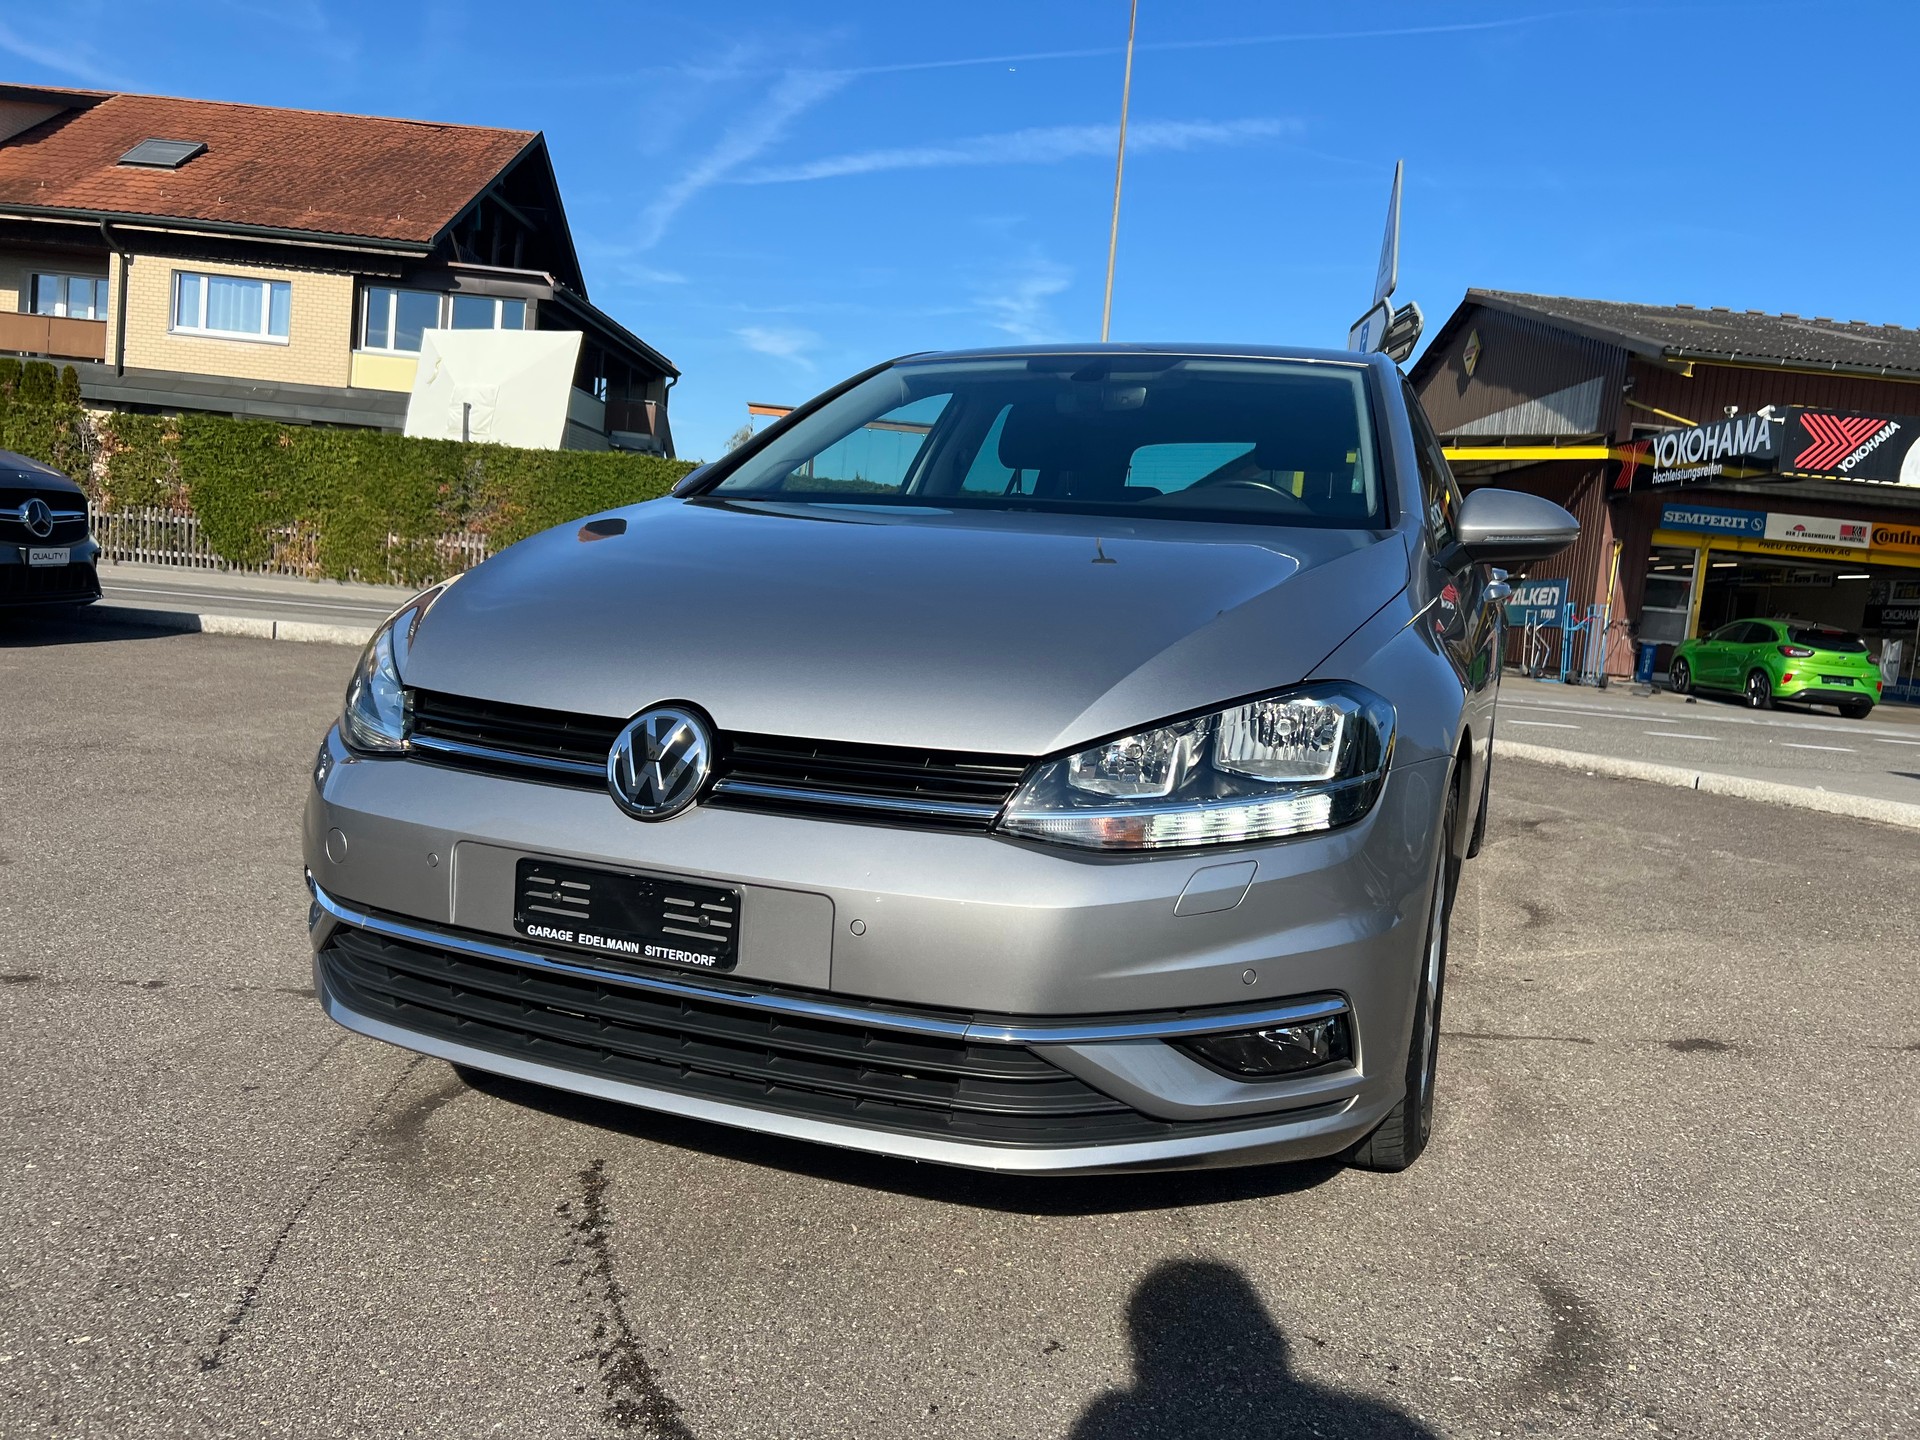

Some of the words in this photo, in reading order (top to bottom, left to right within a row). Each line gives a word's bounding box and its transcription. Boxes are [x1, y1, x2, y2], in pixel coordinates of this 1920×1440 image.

[1653, 417, 1771, 469] YOKOHAMA
[1838, 421, 1901, 472] YOKOHAMA
[1652, 463, 1723, 484] Hochleistungsreifen
[1663, 511, 1748, 529] SEMPERIT
[1758, 541, 1781, 550] PNEU
[1785, 543, 1835, 555] EDELMANN
[1837, 549, 1851, 557] AG
[527, 924, 573, 942] GARAGE
[578, 933, 639, 953] EDELMANN
[644, 945, 716, 967] SITTERDORF
